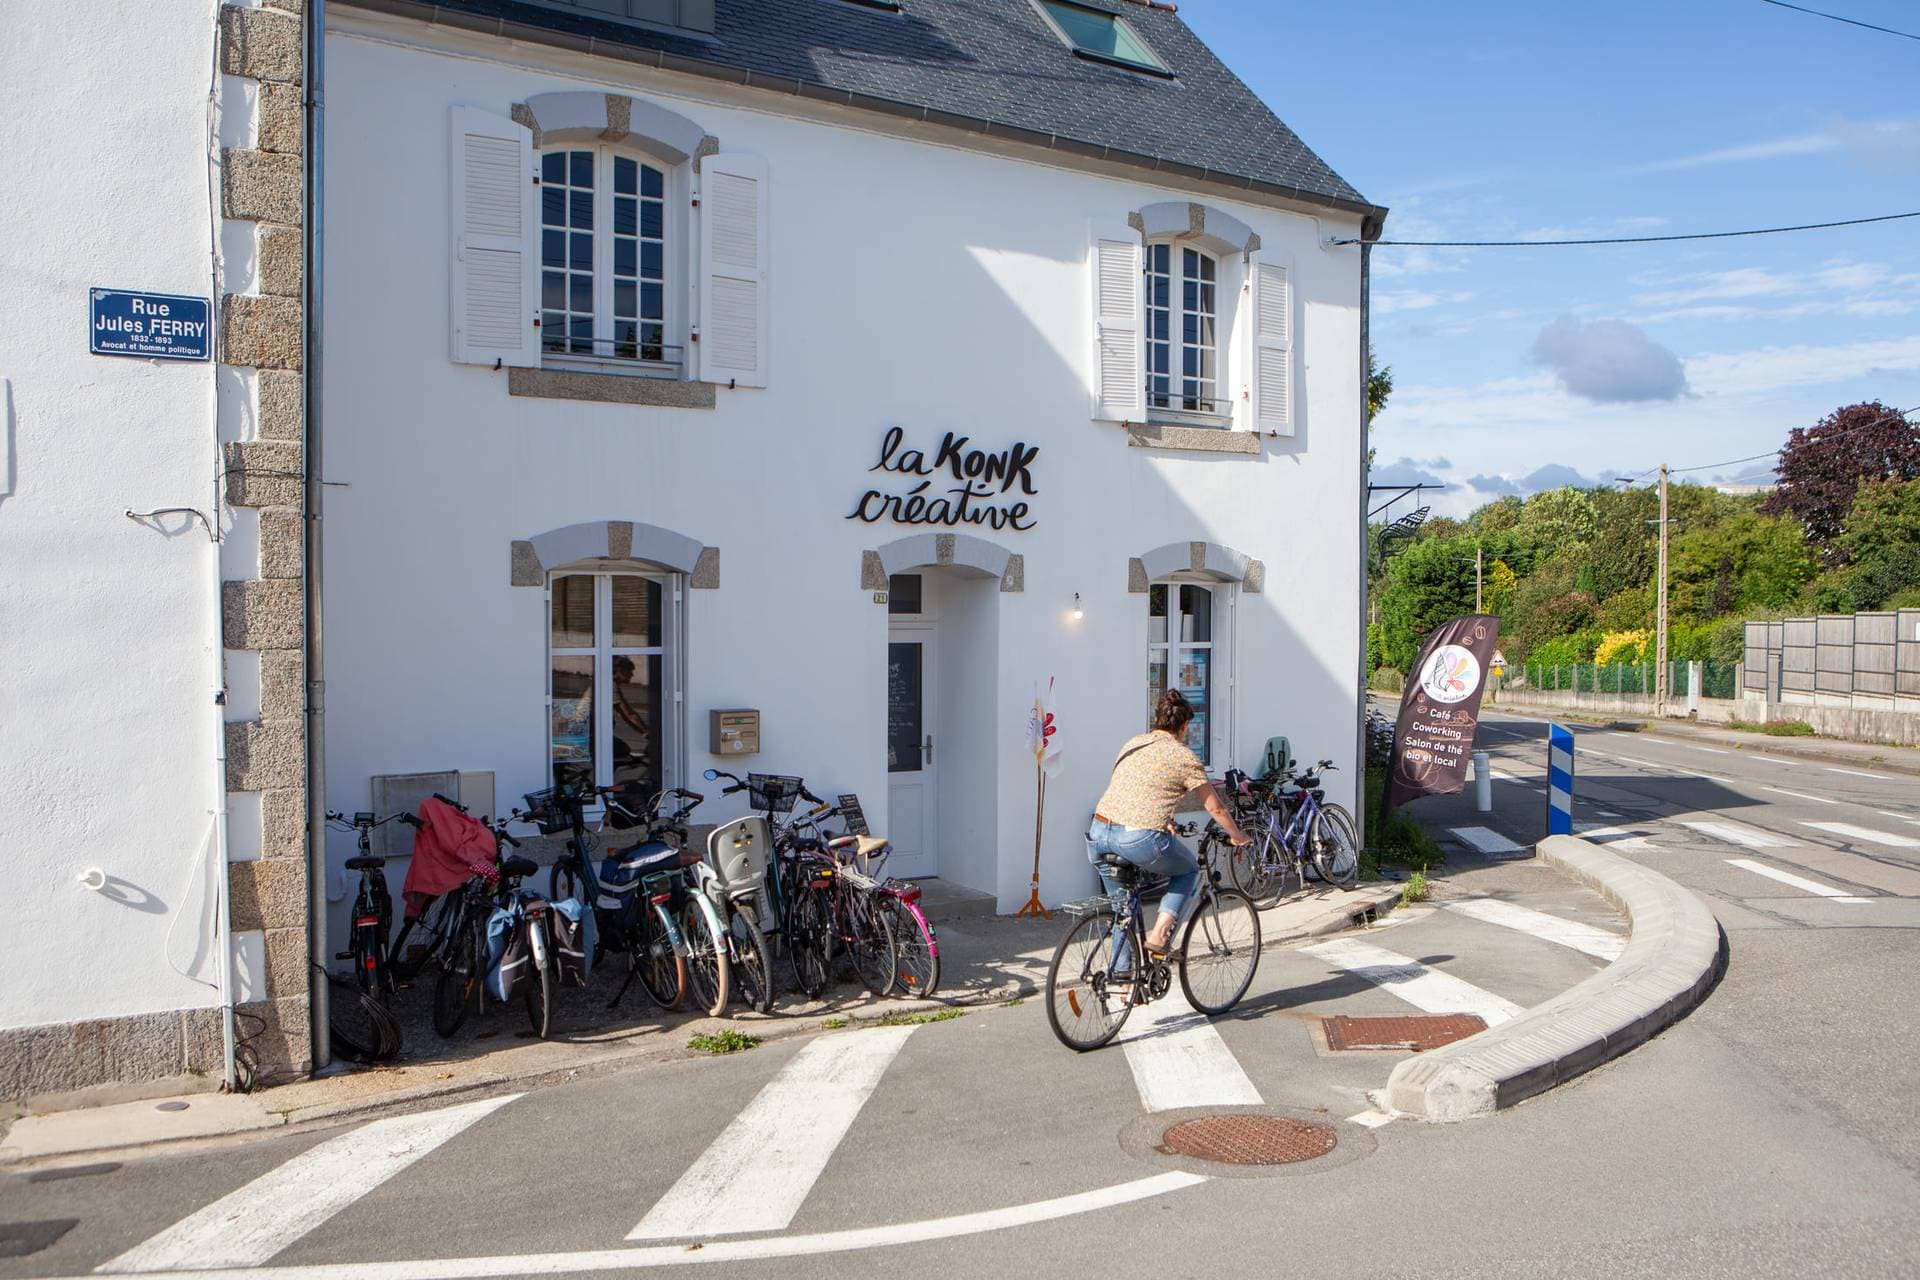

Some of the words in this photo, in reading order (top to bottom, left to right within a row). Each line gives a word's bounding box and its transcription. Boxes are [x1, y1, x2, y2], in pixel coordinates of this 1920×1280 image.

[132, 298, 170, 316] Rue
[95, 314, 144, 333] Jules
[150, 318, 205, 338] FERRY
[101, 340, 127, 349] Avocat
[139, 343, 166, 352] homme
[168, 346, 201, 356] politique
[868, 426, 934, 476] la
[845, 480, 1038, 531] créative
[1430, 708, 1452, 720] Café
[1412, 721, 1462, 740] Coworking
[1405, 736, 1432, 749] Salon
[1434, 742, 1446, 752] de
[1447, 744, 1463, 755] thé
[1406, 750, 1421, 760] bio
[1422, 754, 1432, 763] et
[1434, 755, 1457, 767] local
